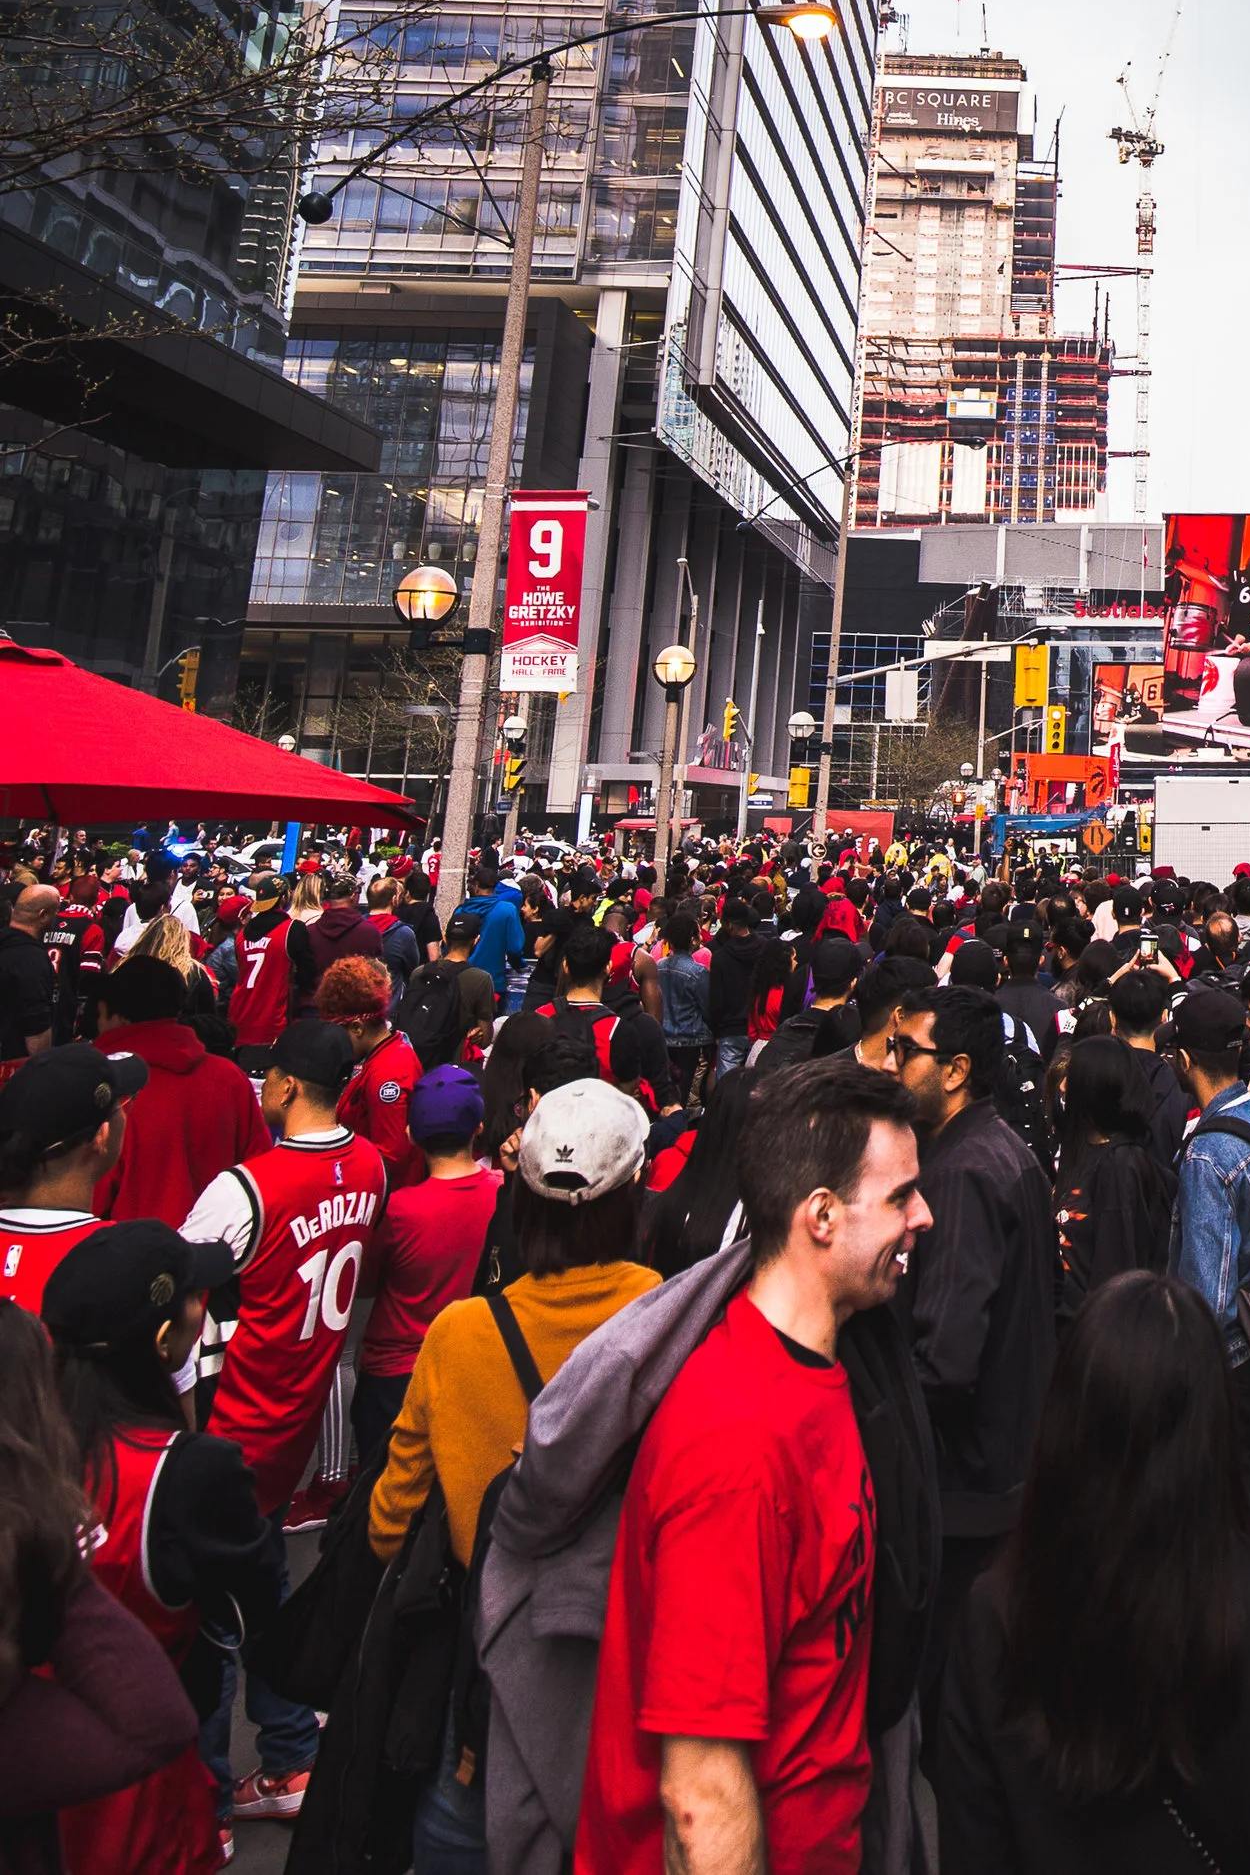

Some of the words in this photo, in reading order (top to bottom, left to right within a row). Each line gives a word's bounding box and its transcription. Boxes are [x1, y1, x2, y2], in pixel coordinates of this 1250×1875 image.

[916, 93, 991, 108] SQUARE
[936, 112, 980, 126] Hines
[528, 520, 563, 578] 9
[522, 592, 564, 605] HOWE
[1239, 586, 1250, 604] 6
[509, 606, 576, 619] GRETZKY
[512, 655, 567, 666] HOCKEY
[512, 668, 534, 676] HALL
[542, 668, 567, 676] FAME
[246, 953, 265, 988] 7
[289, 1191, 377, 1248] DeROZAN
[297, 1240, 363, 1341] 10
